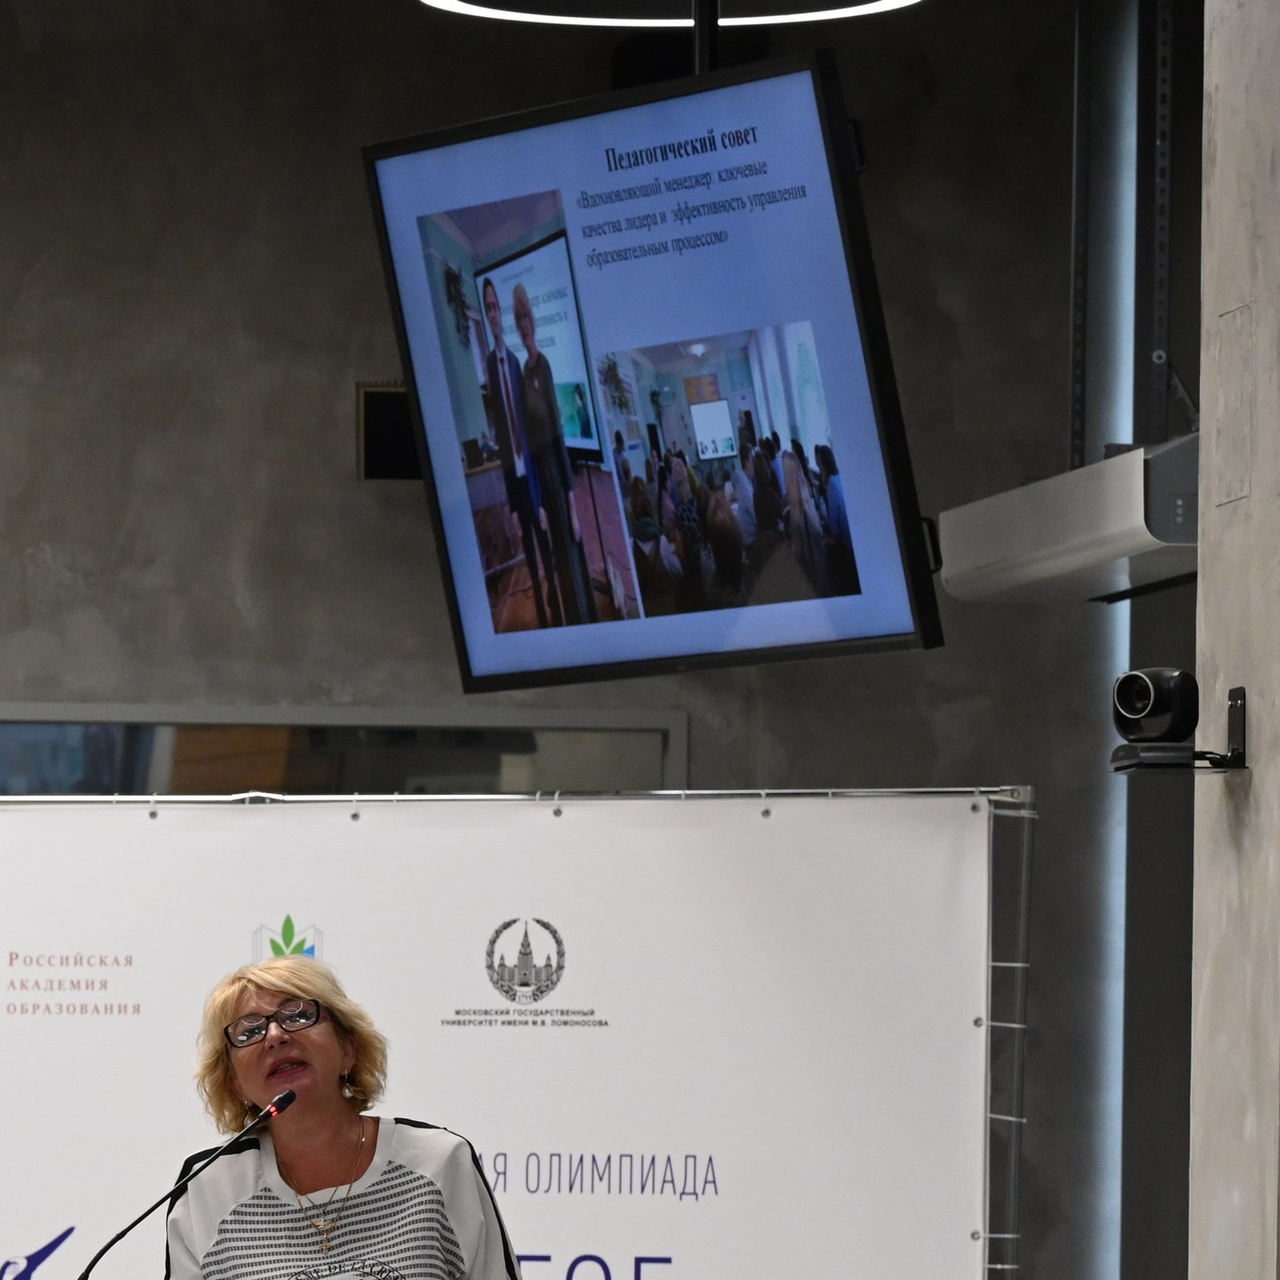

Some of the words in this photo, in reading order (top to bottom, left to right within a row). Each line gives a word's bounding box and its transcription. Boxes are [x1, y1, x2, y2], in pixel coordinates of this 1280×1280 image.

[604, 128, 718, 172] Педагогический
[721, 126, 759, 150] совет
[577, 177, 662, 209] «Вдохновляющий
[717, 161, 768, 183] ключевые
[581, 219, 623, 239] качества
[624, 212, 659, 232] лидера
[659, 211, 668, 225] и
[672, 196, 747, 226] эффективность
[747, 185, 808, 213] управления
[586, 240, 670, 271] образовательным
[671, 230, 729, 256] процессом»
[7, 978, 109, 992] АКАДЕМИЯ
[6, 1003, 141, 1015] ОБРАЗОВАНИЯ
[454, 1008, 510, 1016] МОСКОВСКИЙ
[512, 1008, 595, 1017] ГОСУДАРСТВЕННЫЙ
[501, 1019, 529, 1027] ИМЕНИ
[551, 1019, 609, 1027] ЛОМОНОСОВА
[525, 1152, 719, 1202] ОЛИМПИАДА
